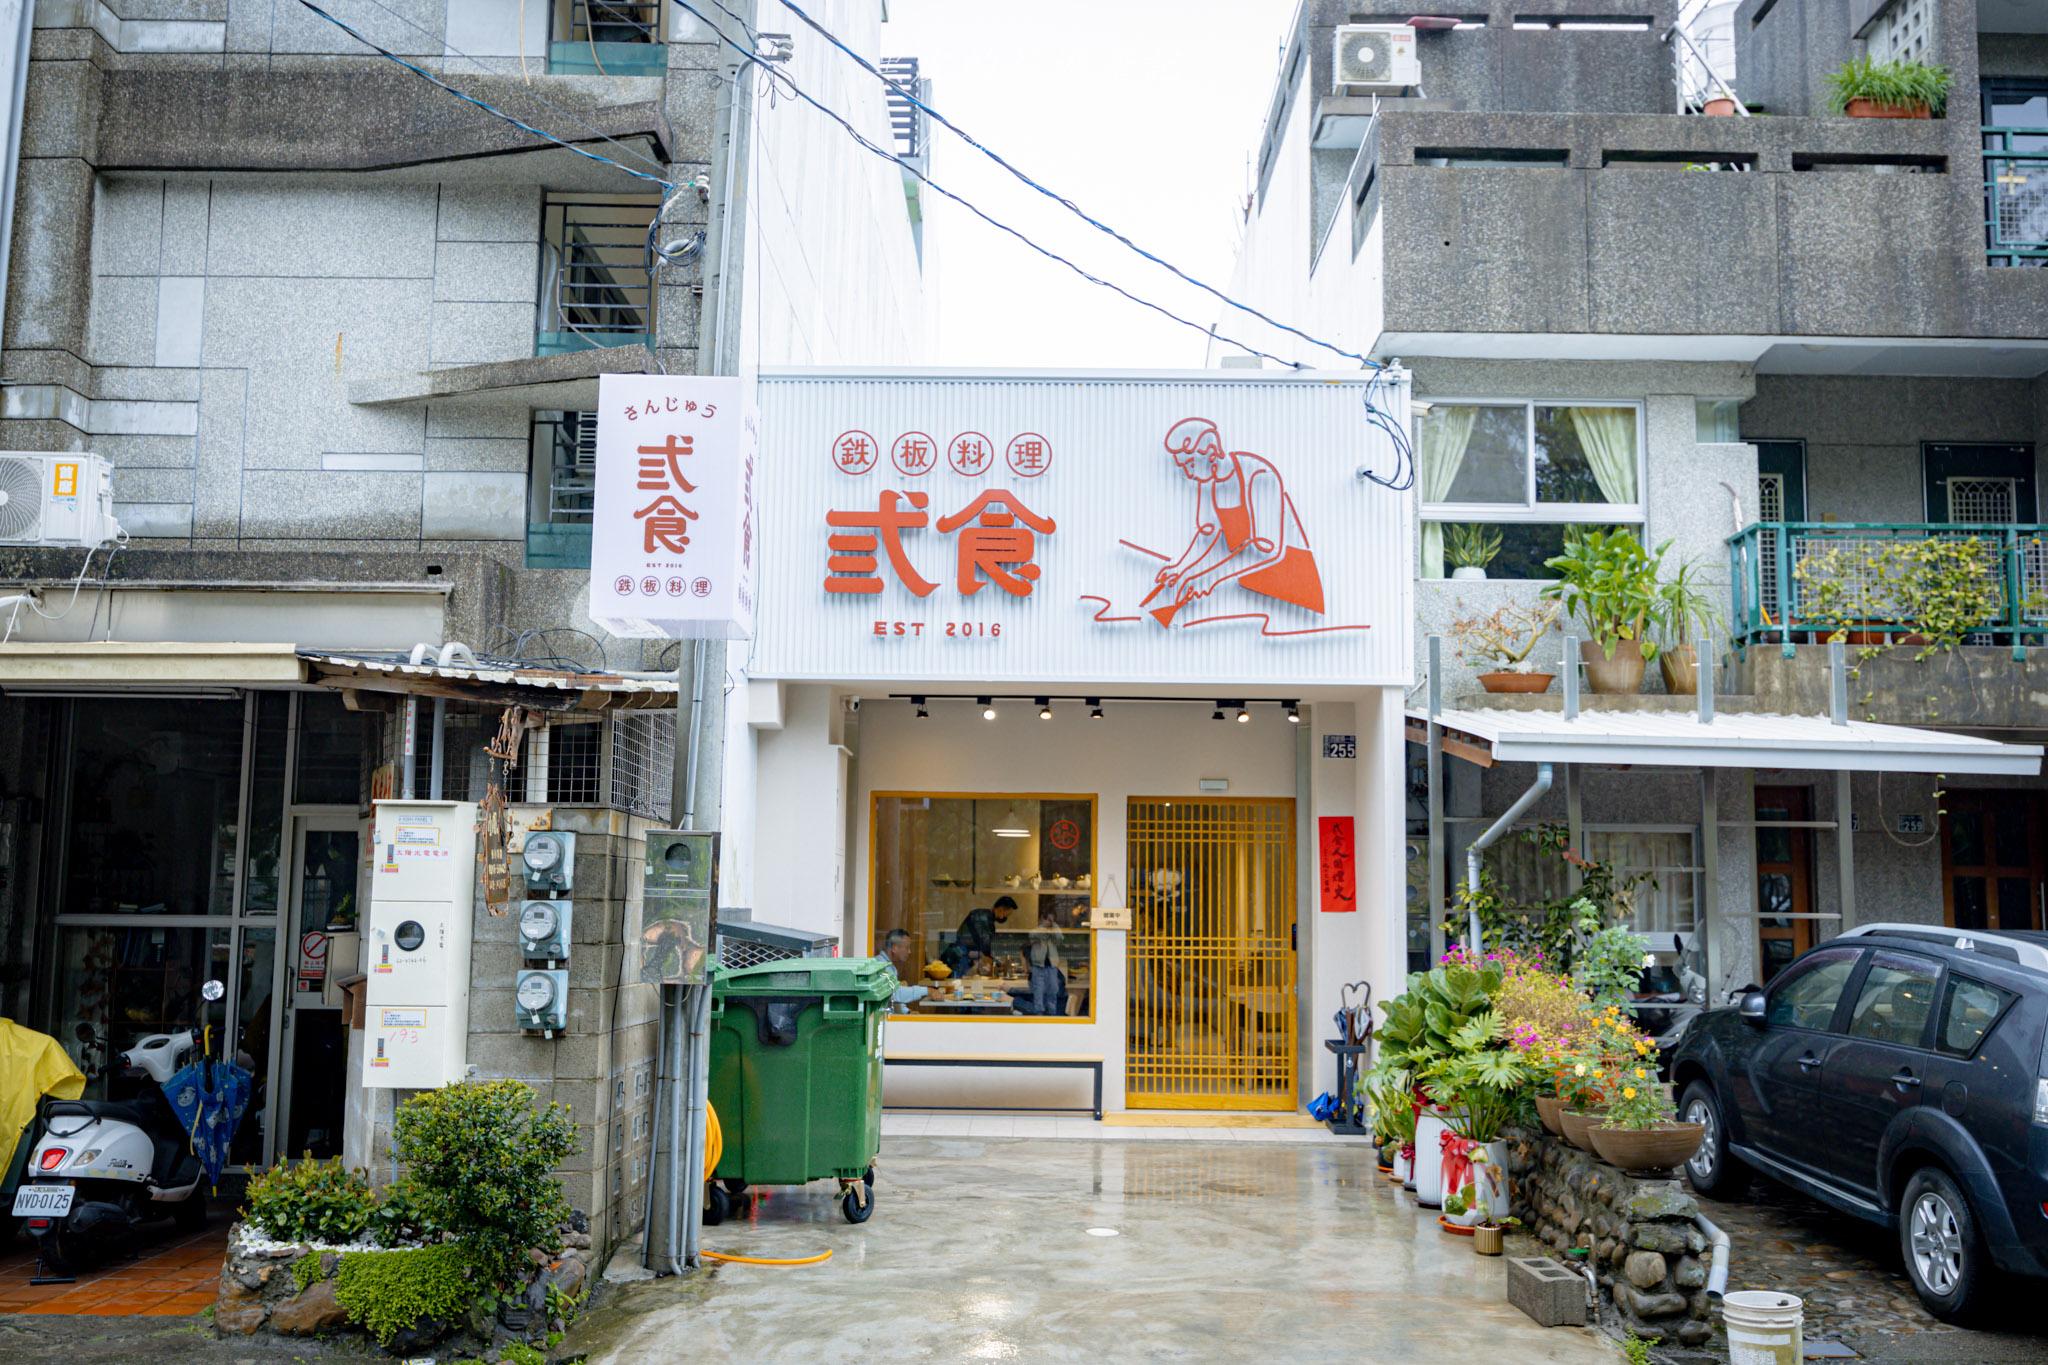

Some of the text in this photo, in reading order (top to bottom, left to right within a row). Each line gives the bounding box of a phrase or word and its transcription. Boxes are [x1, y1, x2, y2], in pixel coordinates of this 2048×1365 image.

[624, 396, 718, 421] さんじゅう
[835, 433, 1050, 474] 鉄板料理
[873, 622, 1001, 637] EST 2016
[1330, 743, 1355, 758] 255
